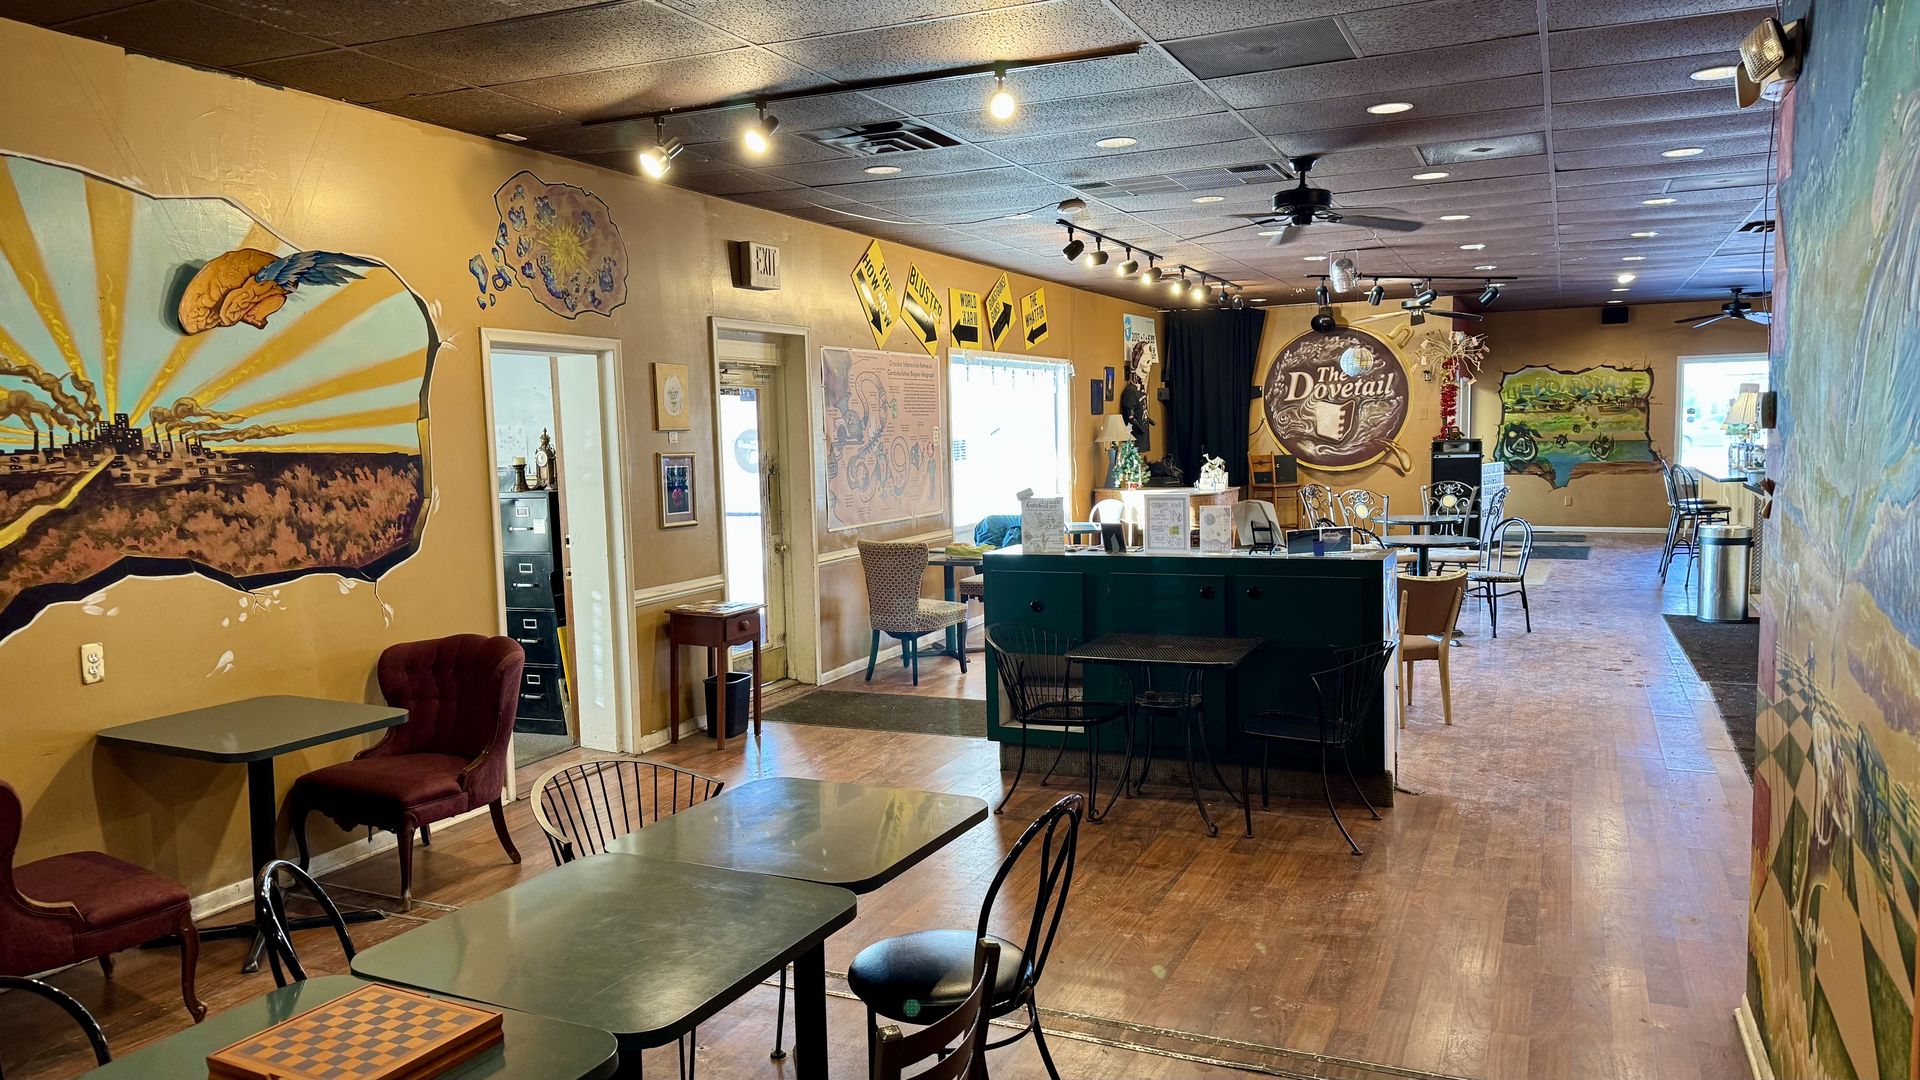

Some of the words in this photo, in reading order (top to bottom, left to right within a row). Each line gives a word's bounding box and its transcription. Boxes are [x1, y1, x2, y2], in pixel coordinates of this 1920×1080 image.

[756, 246, 777, 276] EXIT
[862, 253, 880, 292] HOW
[877, 292, 892, 328] NOW
[880, 262, 893, 296] THE
[959, 292, 976, 309] WORLD
[1029, 293, 1038, 309] THE
[1284, 371, 1395, 402] Dovetail
[1317, 366, 1348, 382] The
